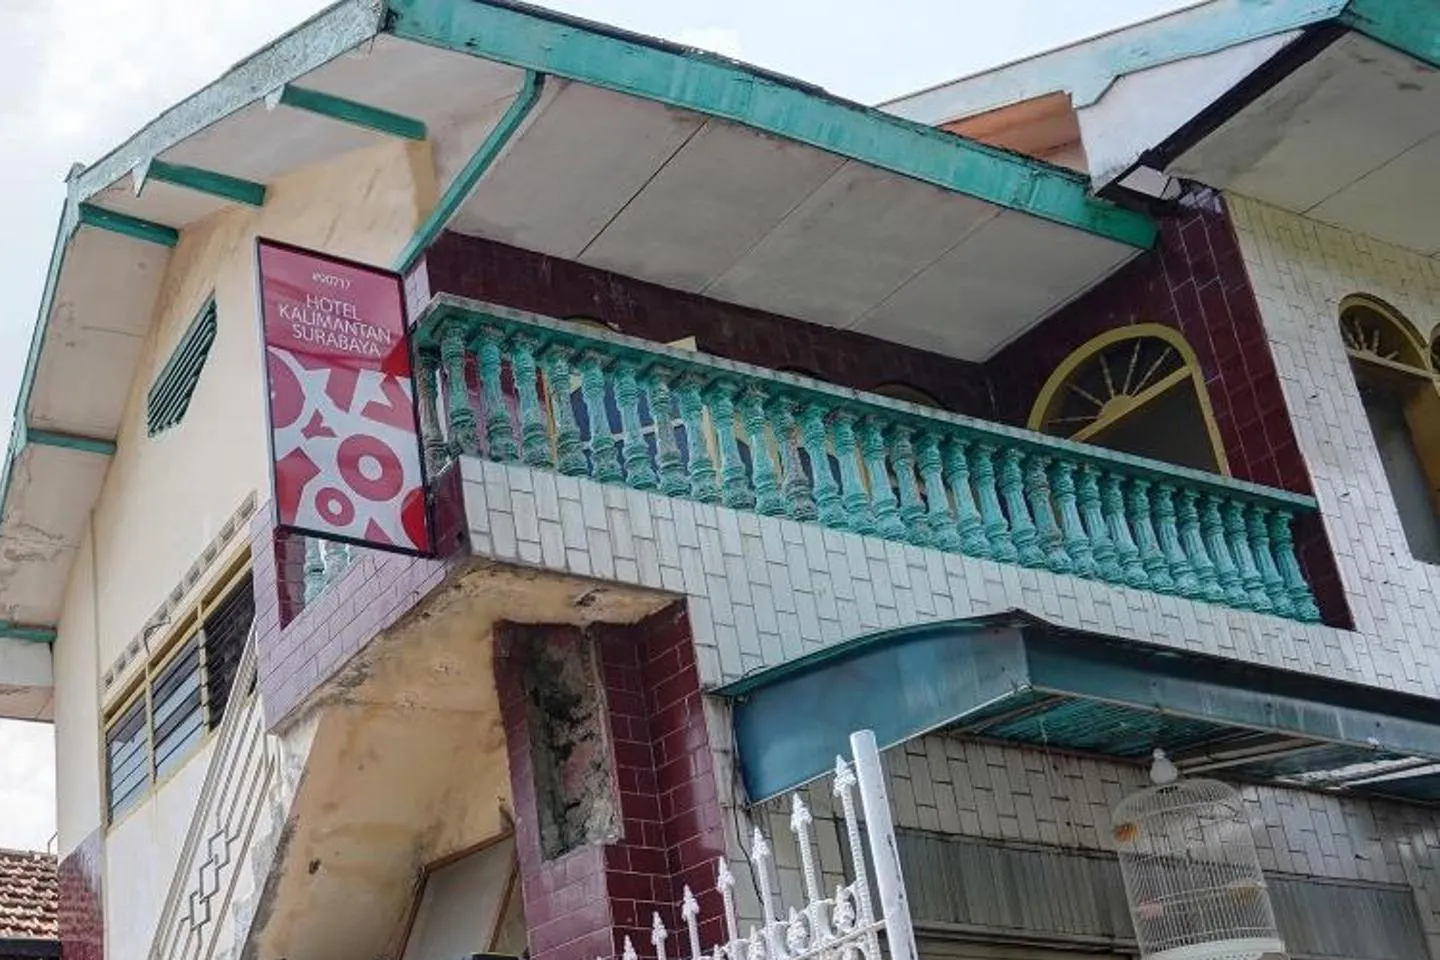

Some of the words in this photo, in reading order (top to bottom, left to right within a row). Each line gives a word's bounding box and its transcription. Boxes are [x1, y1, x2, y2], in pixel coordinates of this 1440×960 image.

[306, 293, 361, 320] HOTEL
[278, 304, 391, 344] KALIMANTAN
[292, 324, 381, 357] SURABAYA
